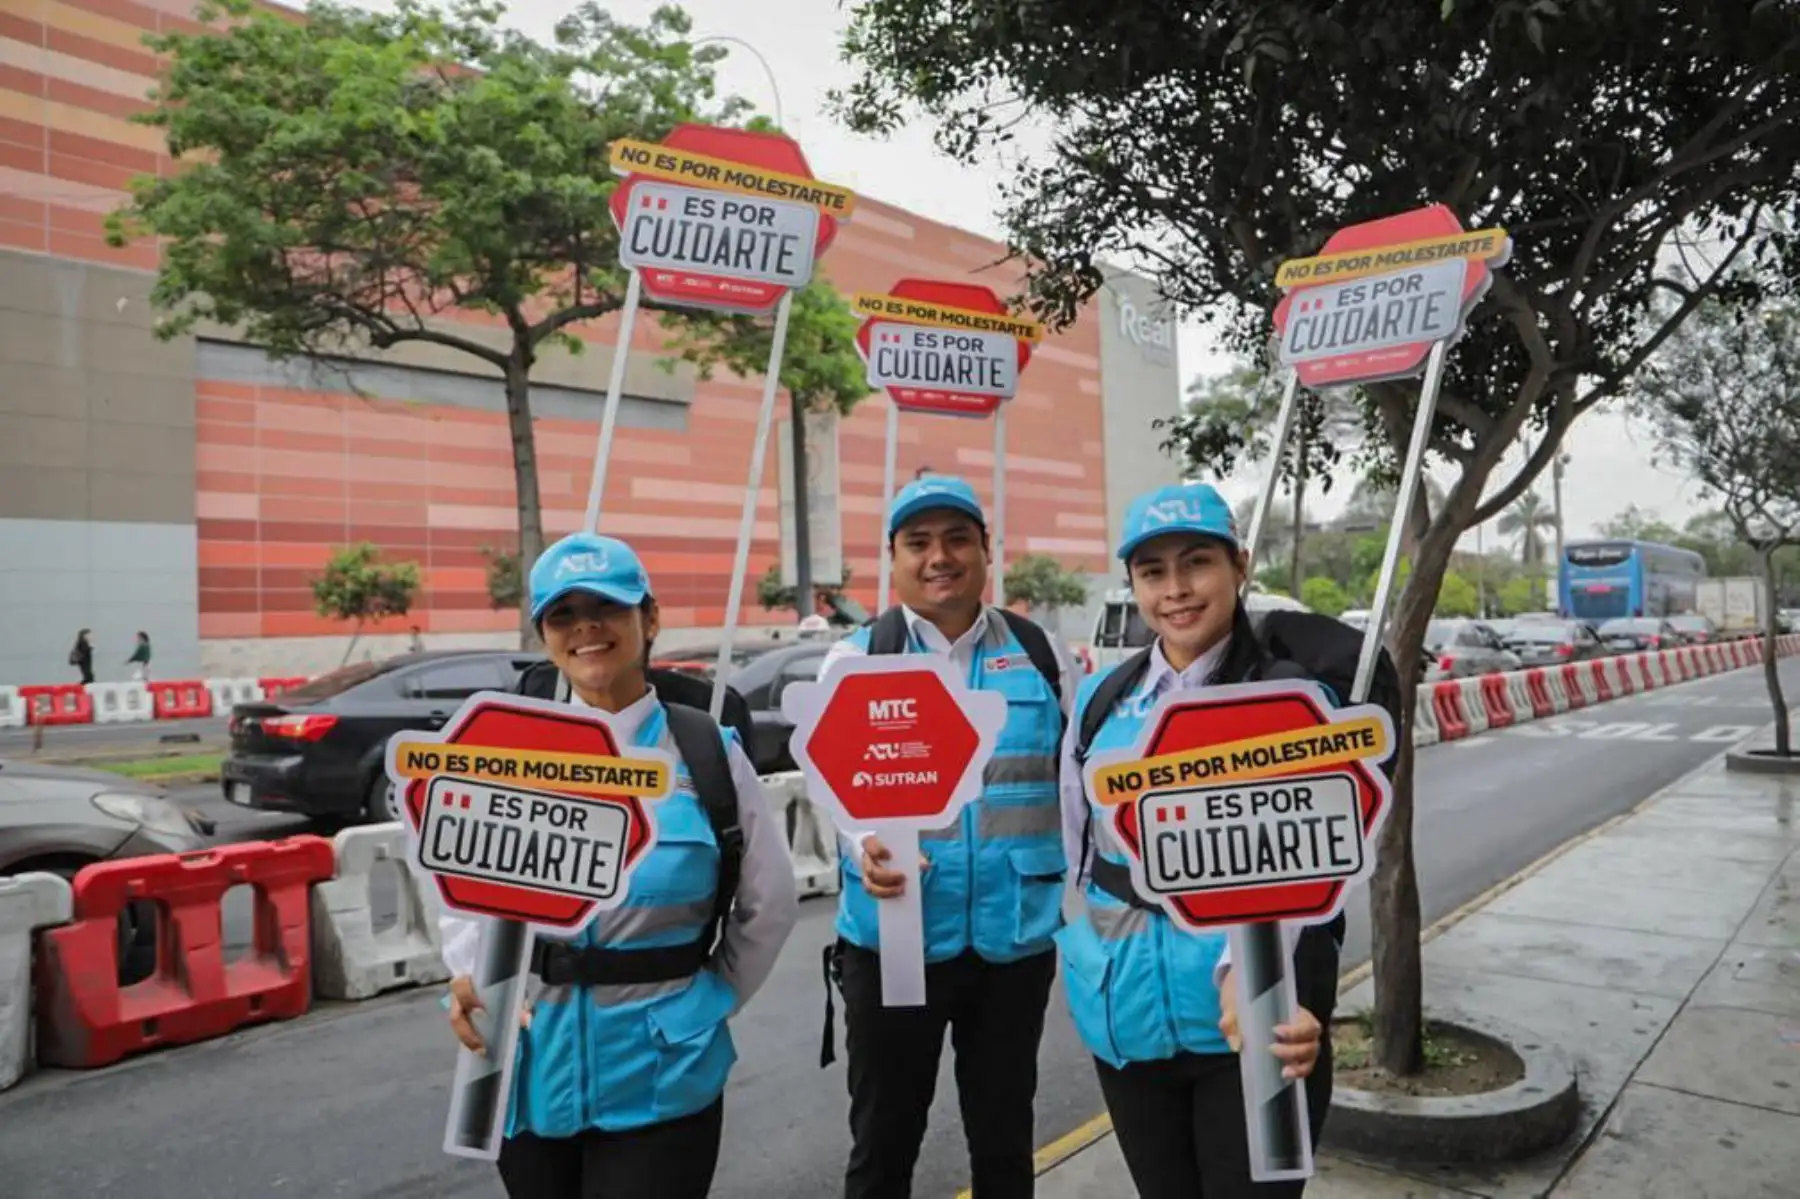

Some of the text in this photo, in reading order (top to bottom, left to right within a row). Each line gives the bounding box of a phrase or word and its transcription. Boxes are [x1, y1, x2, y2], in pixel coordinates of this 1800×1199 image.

[620, 147, 846, 210] NO ES POR MOLESTARTE
[683, 196, 776, 226] ES POR
[630, 215, 798, 276] CUIDARTE
[1284, 236, 1494, 280] NO ES POR MOLESTARTE
[1338, 273, 1424, 306] ES POR
[858, 298, 1036, 338] NO ES POR MOLESTARTE
[1289, 291, 1446, 354] CUIDARTE
[914, 332, 984, 352] ES POR
[877, 347, 1005, 388] CUIDARTE
[868, 698, 918, 720] MTC
[407, 751, 658, 788] NO ES POR MOLESTARTE
[874, 770, 938, 786] SUTRAN
[1106, 728, 1376, 794] NO ES POR MOLESTARTE
[488, 793, 588, 831] ES POR
[1205, 787, 1313, 820] ES POR
[432, 814, 613, 890] CUIDARTE
[1156, 814, 1352, 882] CUIDARTE
